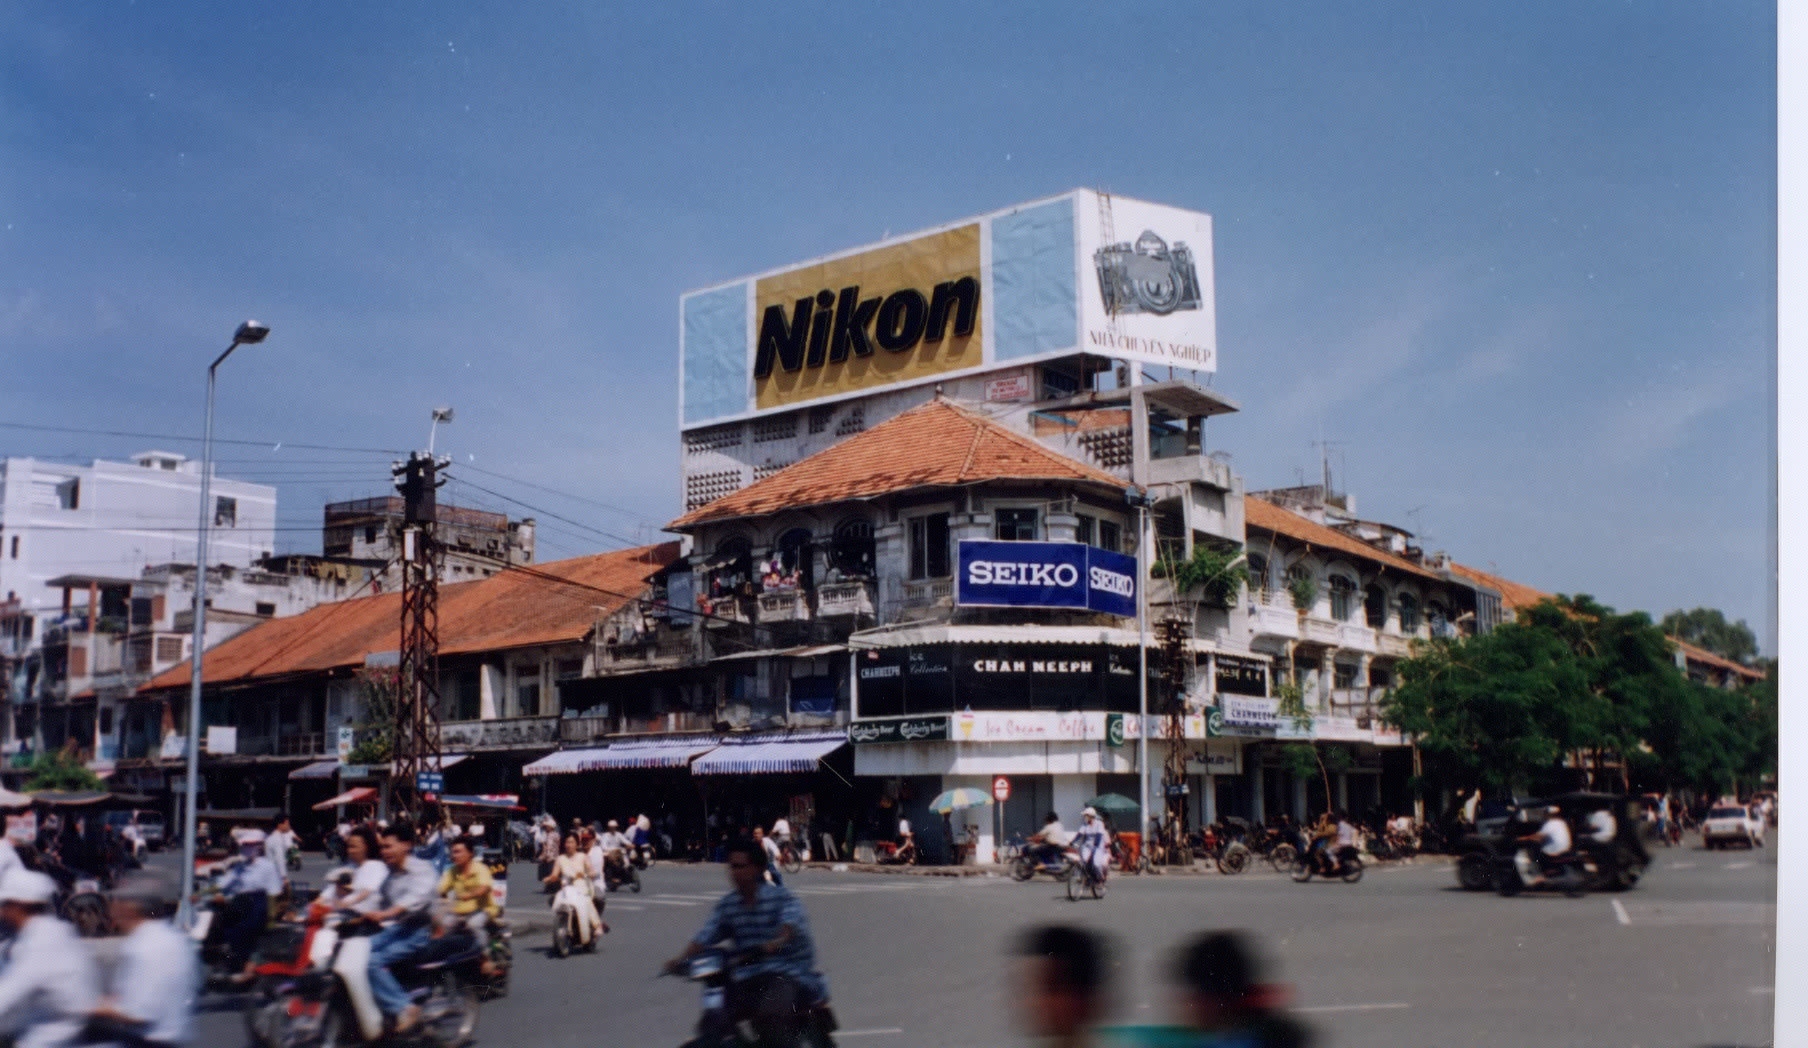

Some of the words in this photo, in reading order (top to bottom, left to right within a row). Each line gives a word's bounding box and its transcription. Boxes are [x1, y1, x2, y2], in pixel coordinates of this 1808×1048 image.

[754, 276, 981, 378] Nikon
[968, 560, 1078, 588] SEIKO
[1089, 566, 1134, 598] SEIKO
[1032, 660, 1093, 673] NEEPH
[852, 723, 880, 741] Carlsberg
[880, 725, 895, 734] Beer
[900, 721, 930, 740] Carlsberg
[930, 722, 946, 732] Beer
[1006, 719, 1046, 737] Cream
